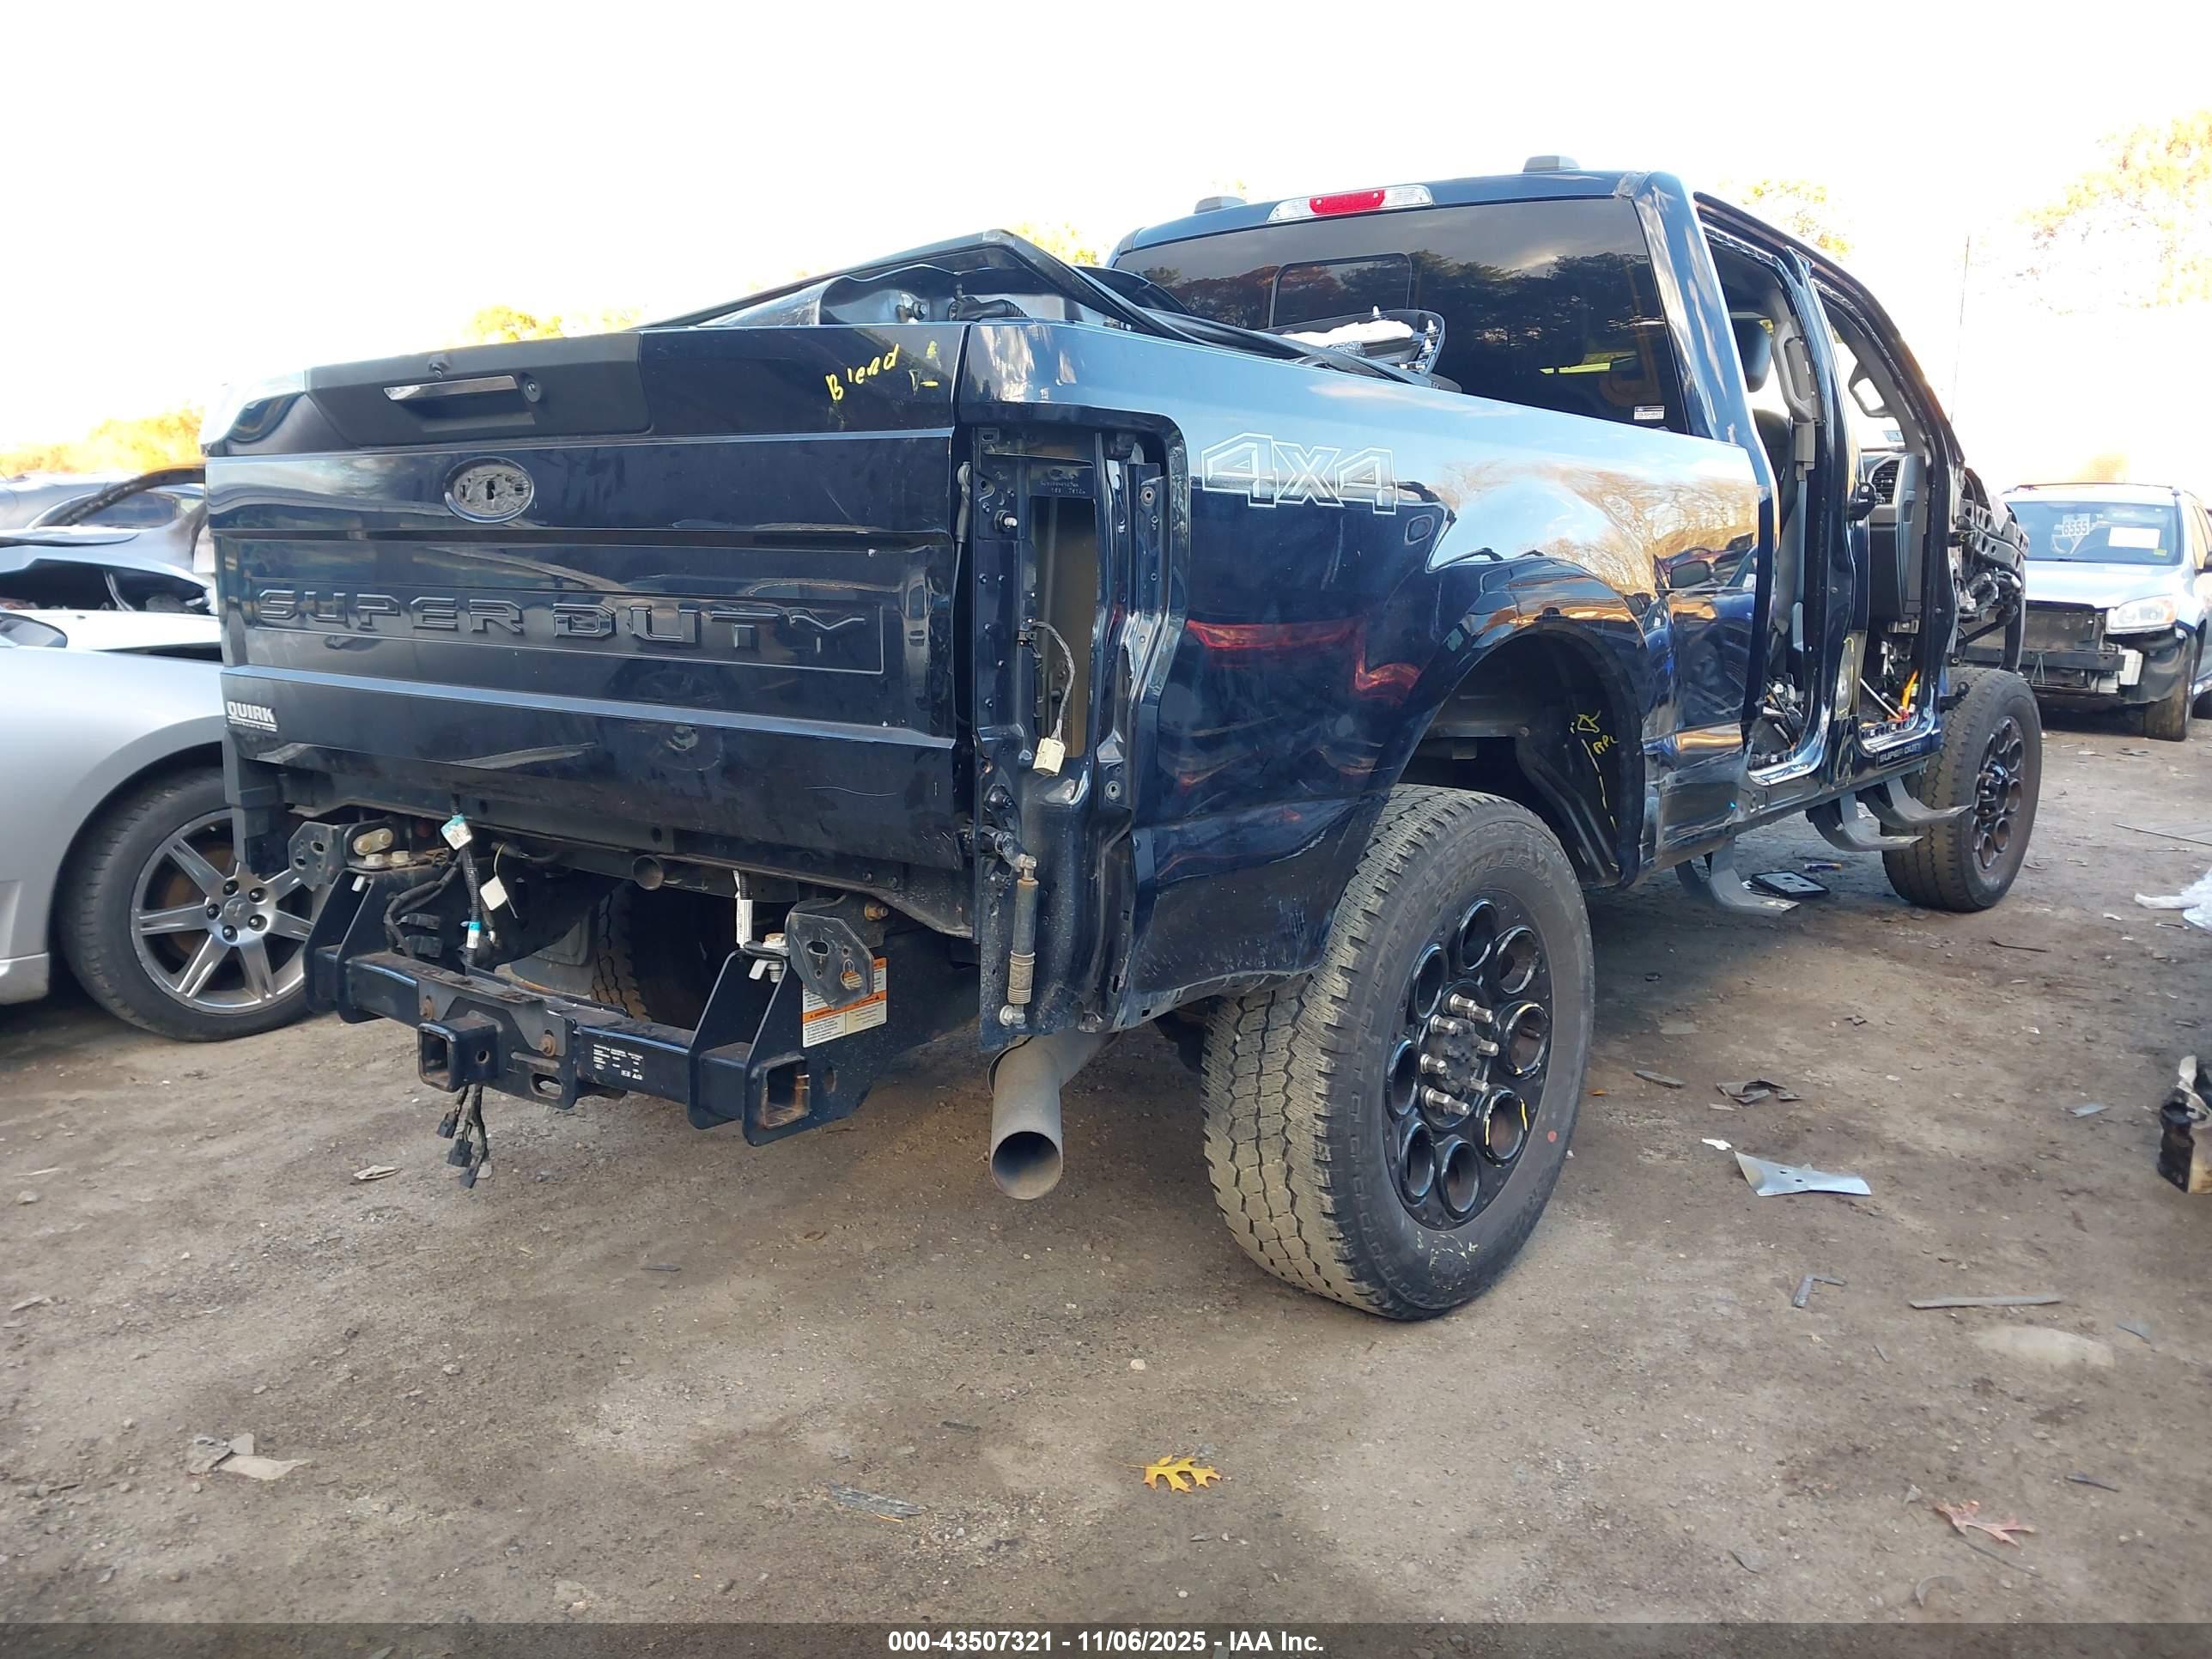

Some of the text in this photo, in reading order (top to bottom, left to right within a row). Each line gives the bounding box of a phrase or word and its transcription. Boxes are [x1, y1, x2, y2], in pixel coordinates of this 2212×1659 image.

[2063, 520, 2088, 535] 6555
[258, 589, 867, 653] SUPER DUTY
[227, 701, 275, 723] QUIRK
